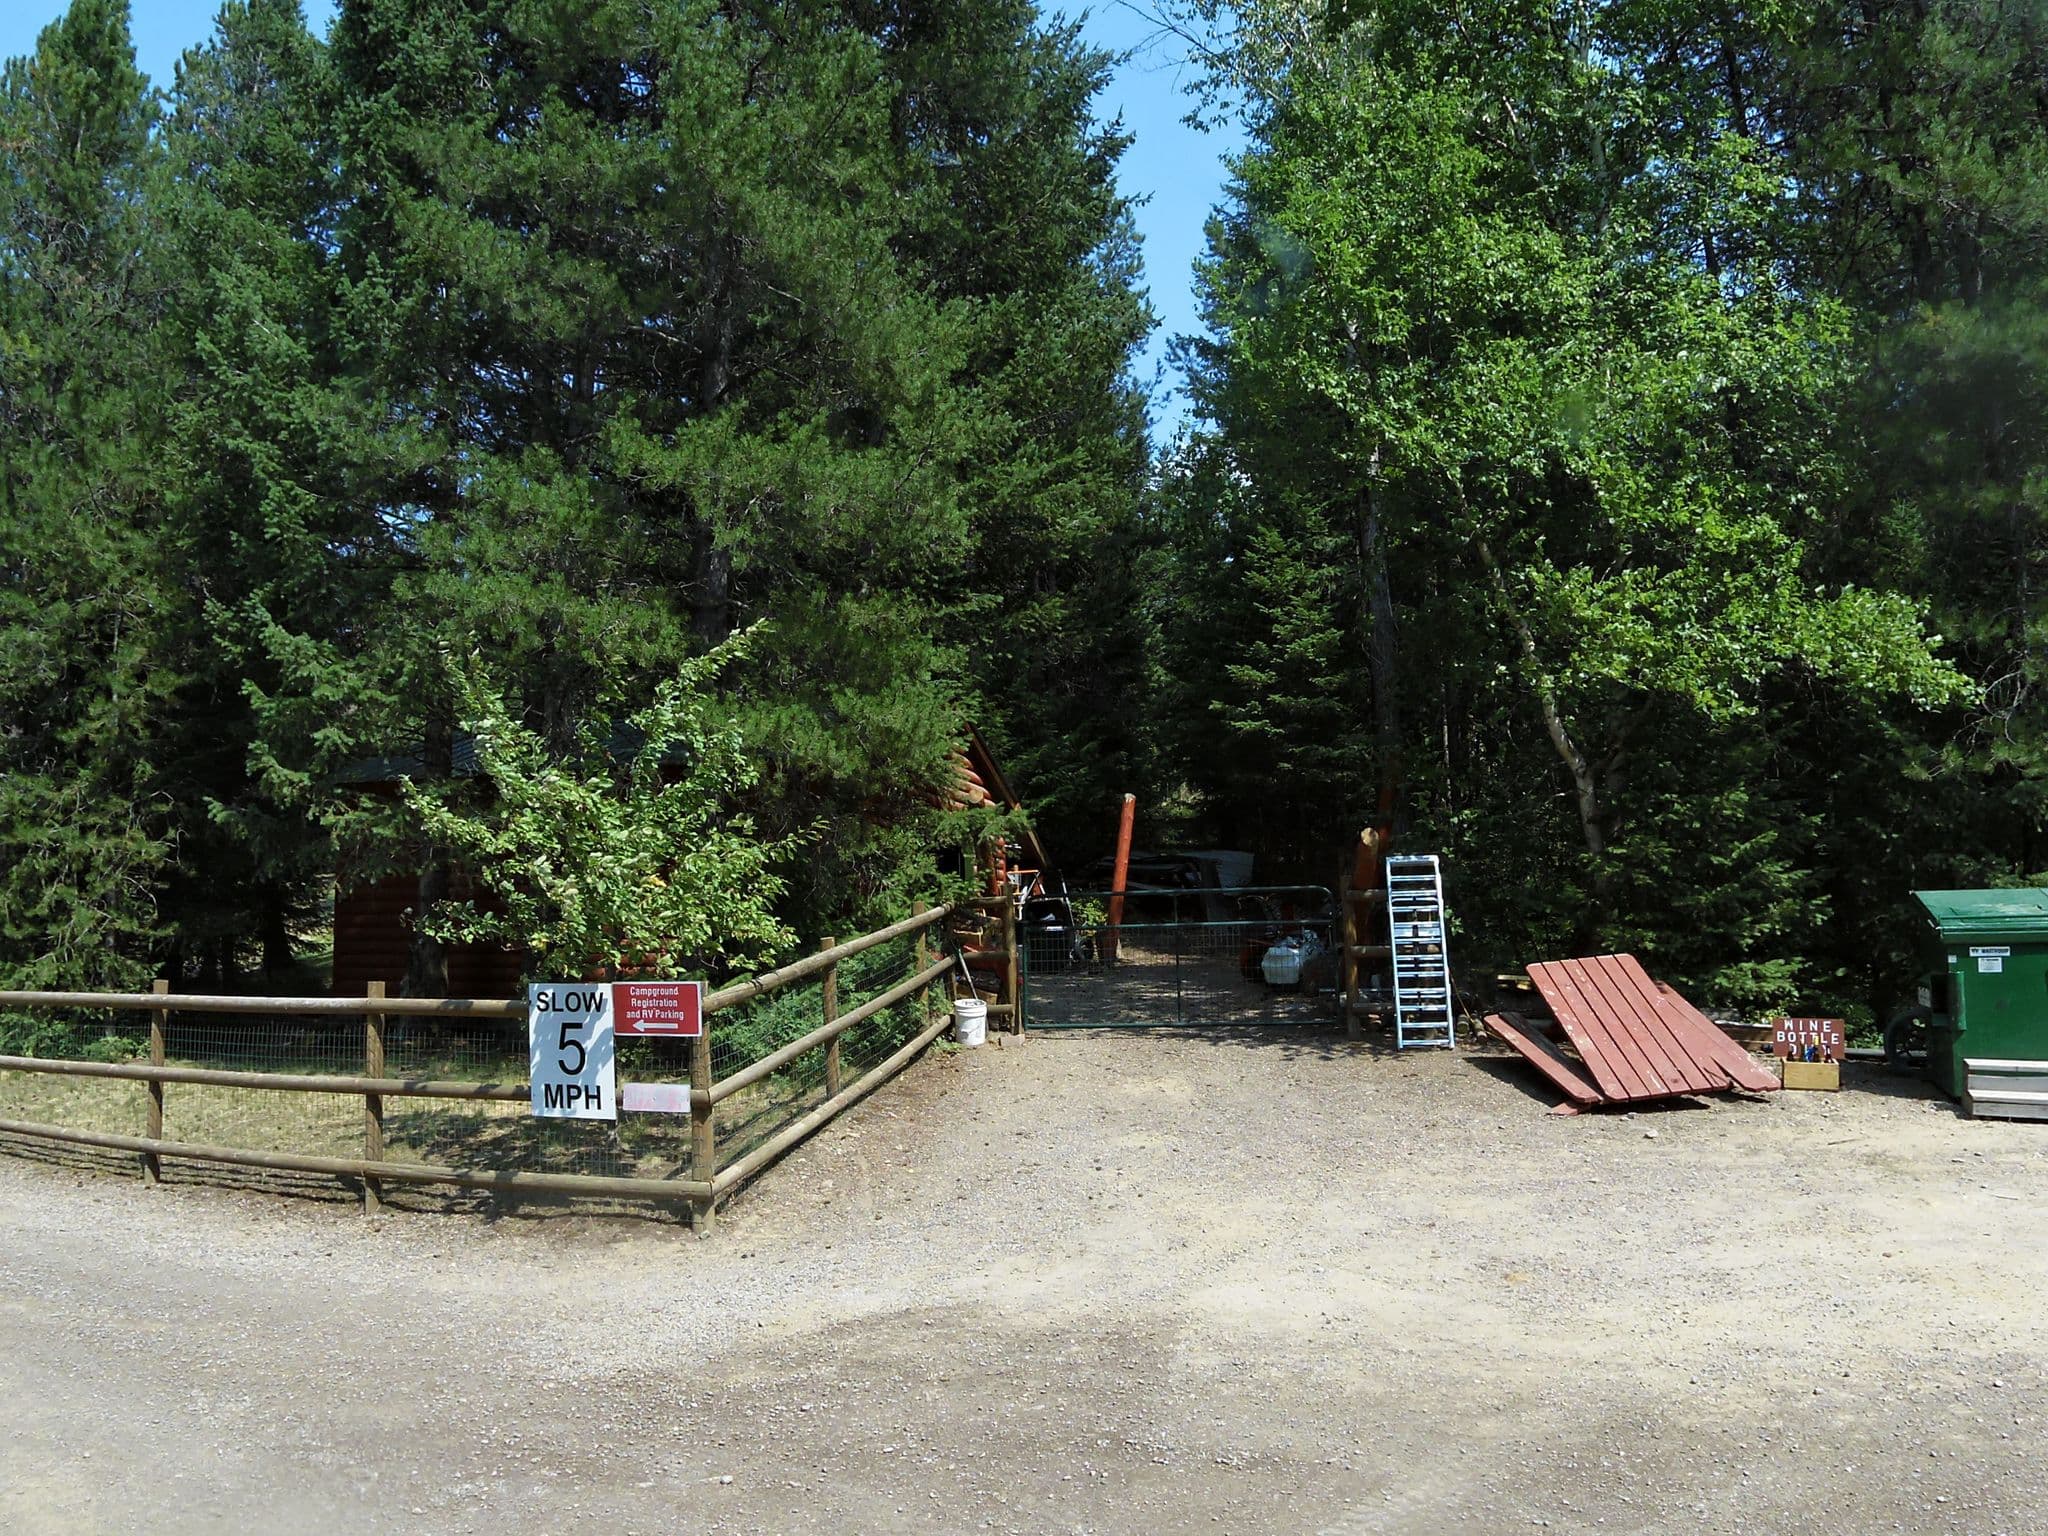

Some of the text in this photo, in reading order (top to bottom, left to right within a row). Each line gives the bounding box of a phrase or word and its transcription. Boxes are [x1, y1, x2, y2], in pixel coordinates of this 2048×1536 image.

[630, 986, 679, 997] Campground
[536, 992, 604, 1012] SLOW
[631, 998, 678, 1008] Registration
[626, 1009, 684, 1020] and RV Parking
[1784, 1019, 1831, 1032] WINE
[1777, 1031, 1839, 1045] BOTTLE
[558, 1022, 586, 1075] 5
[544, 1084, 602, 1110] MPH
